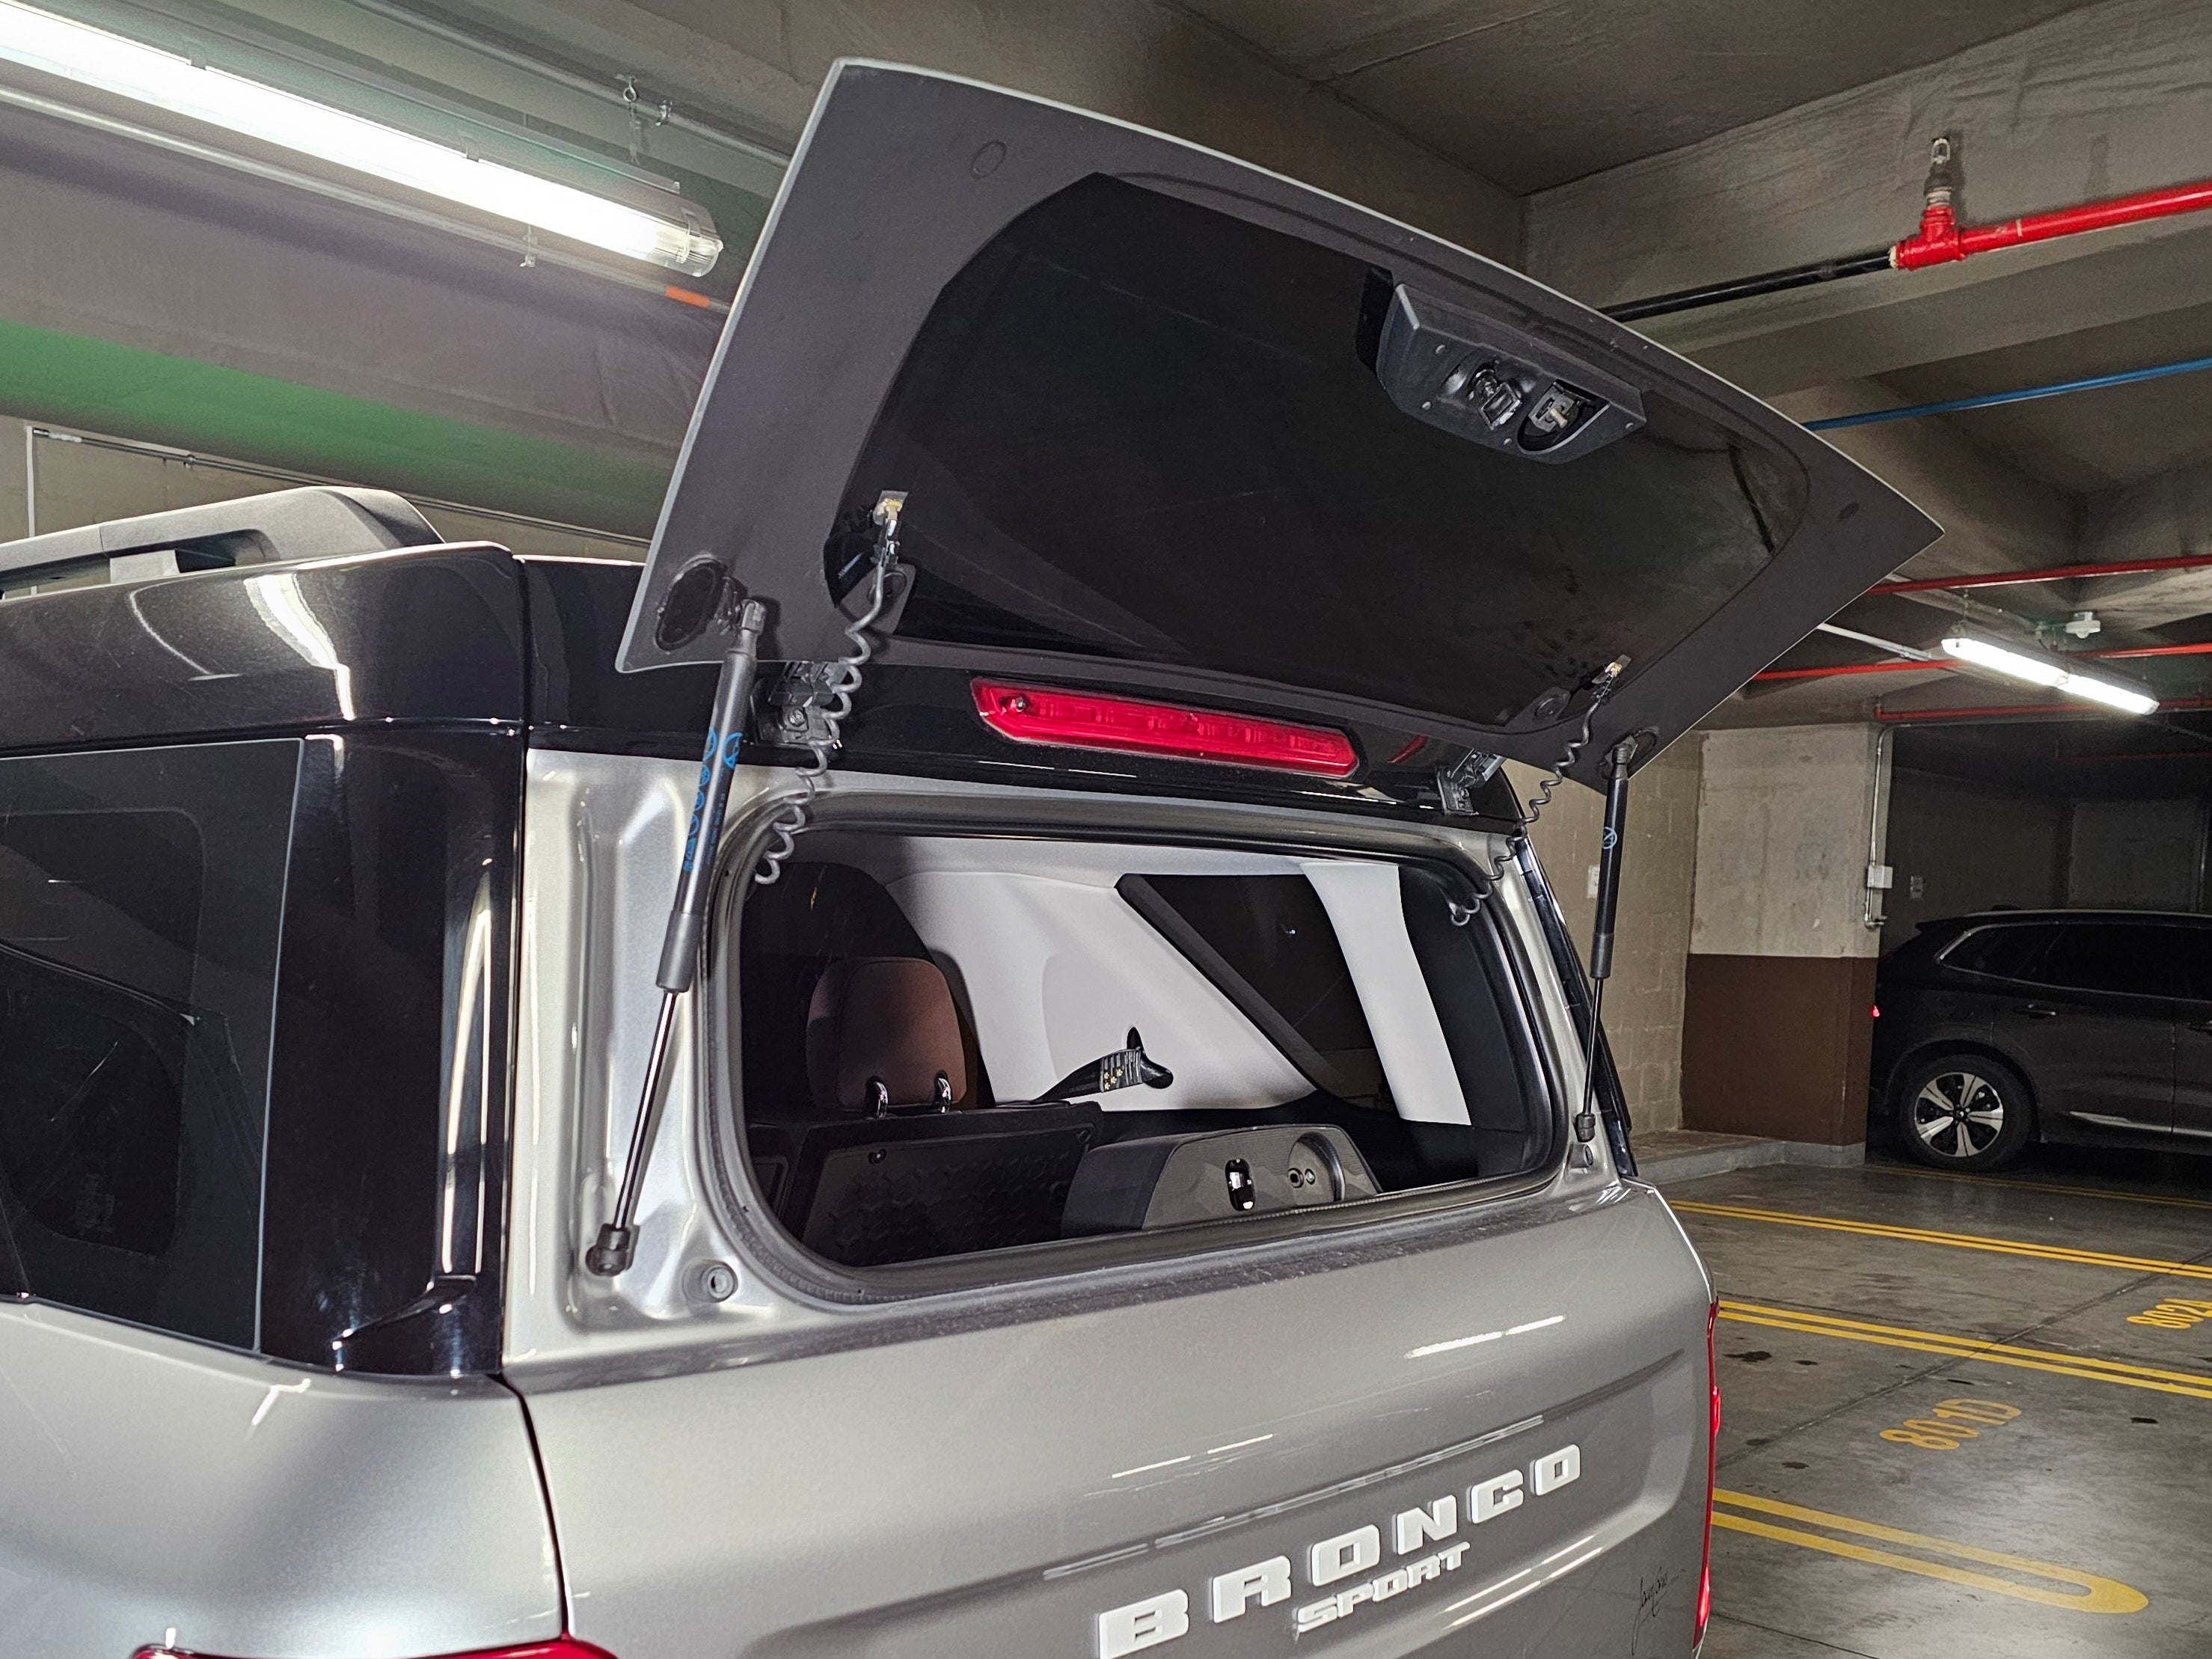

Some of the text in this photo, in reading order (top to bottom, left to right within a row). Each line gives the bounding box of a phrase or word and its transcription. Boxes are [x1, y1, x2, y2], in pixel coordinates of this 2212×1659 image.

[1879, 1398, 2021, 1450] 801D
[1098, 1444, 1581, 1659] BRONCO
[1297, 1541, 1471, 1633] SPORT
